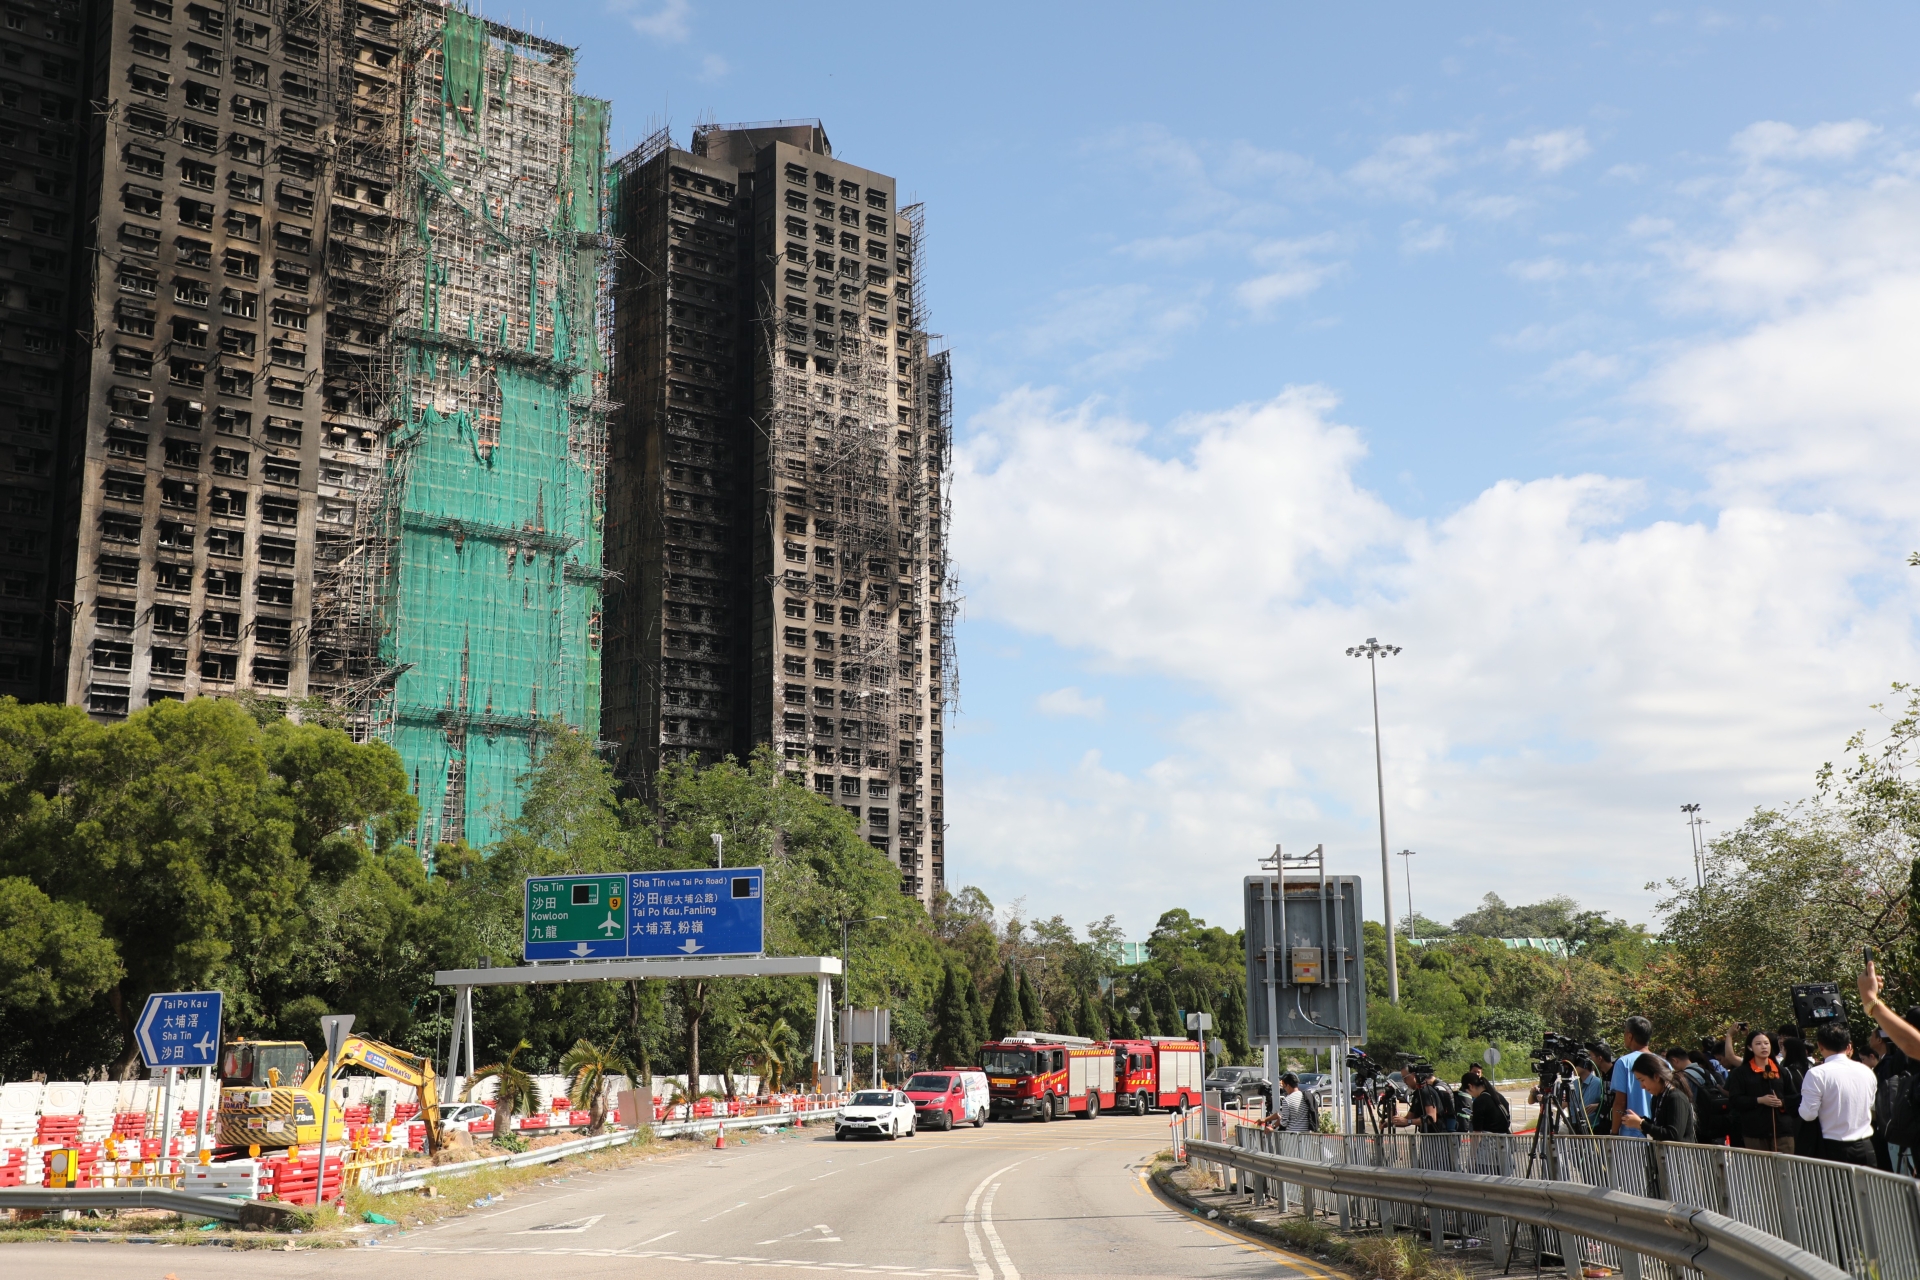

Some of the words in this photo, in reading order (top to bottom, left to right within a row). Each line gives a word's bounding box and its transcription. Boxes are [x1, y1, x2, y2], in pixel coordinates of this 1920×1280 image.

[532, 883, 549, 893] Sha
[551, 882, 564, 891] Tin
[632, 878, 650, 888] Sha
[652, 877, 666, 887] Tin
[667, 879, 680, 888] (via
[682, 878, 692, 886] Tai
[705, 877, 728, 885] Road)
[532, 897, 556, 910] 沙田
[611, 898, 618, 908] 9
[531, 911, 569, 921] Kowloon
[632, 907, 646, 917] Tai
[648, 907, 660, 916] Po
[531, 925, 558, 939] 九龍
[163, 1000, 176, 1009] Tai
[177, 999, 188, 1009] Po
[190, 999, 208, 1008] Kau
[163, 1013, 199, 1029] 大埔滘
[162, 1031, 178, 1041] Sha
[180, 1030, 192, 1040] Tin
[161, 1045, 185, 1060] 沙田
[385, 1064, 412, 1080] KOMATSU
[223, 1101, 254, 1110] KOMATS
